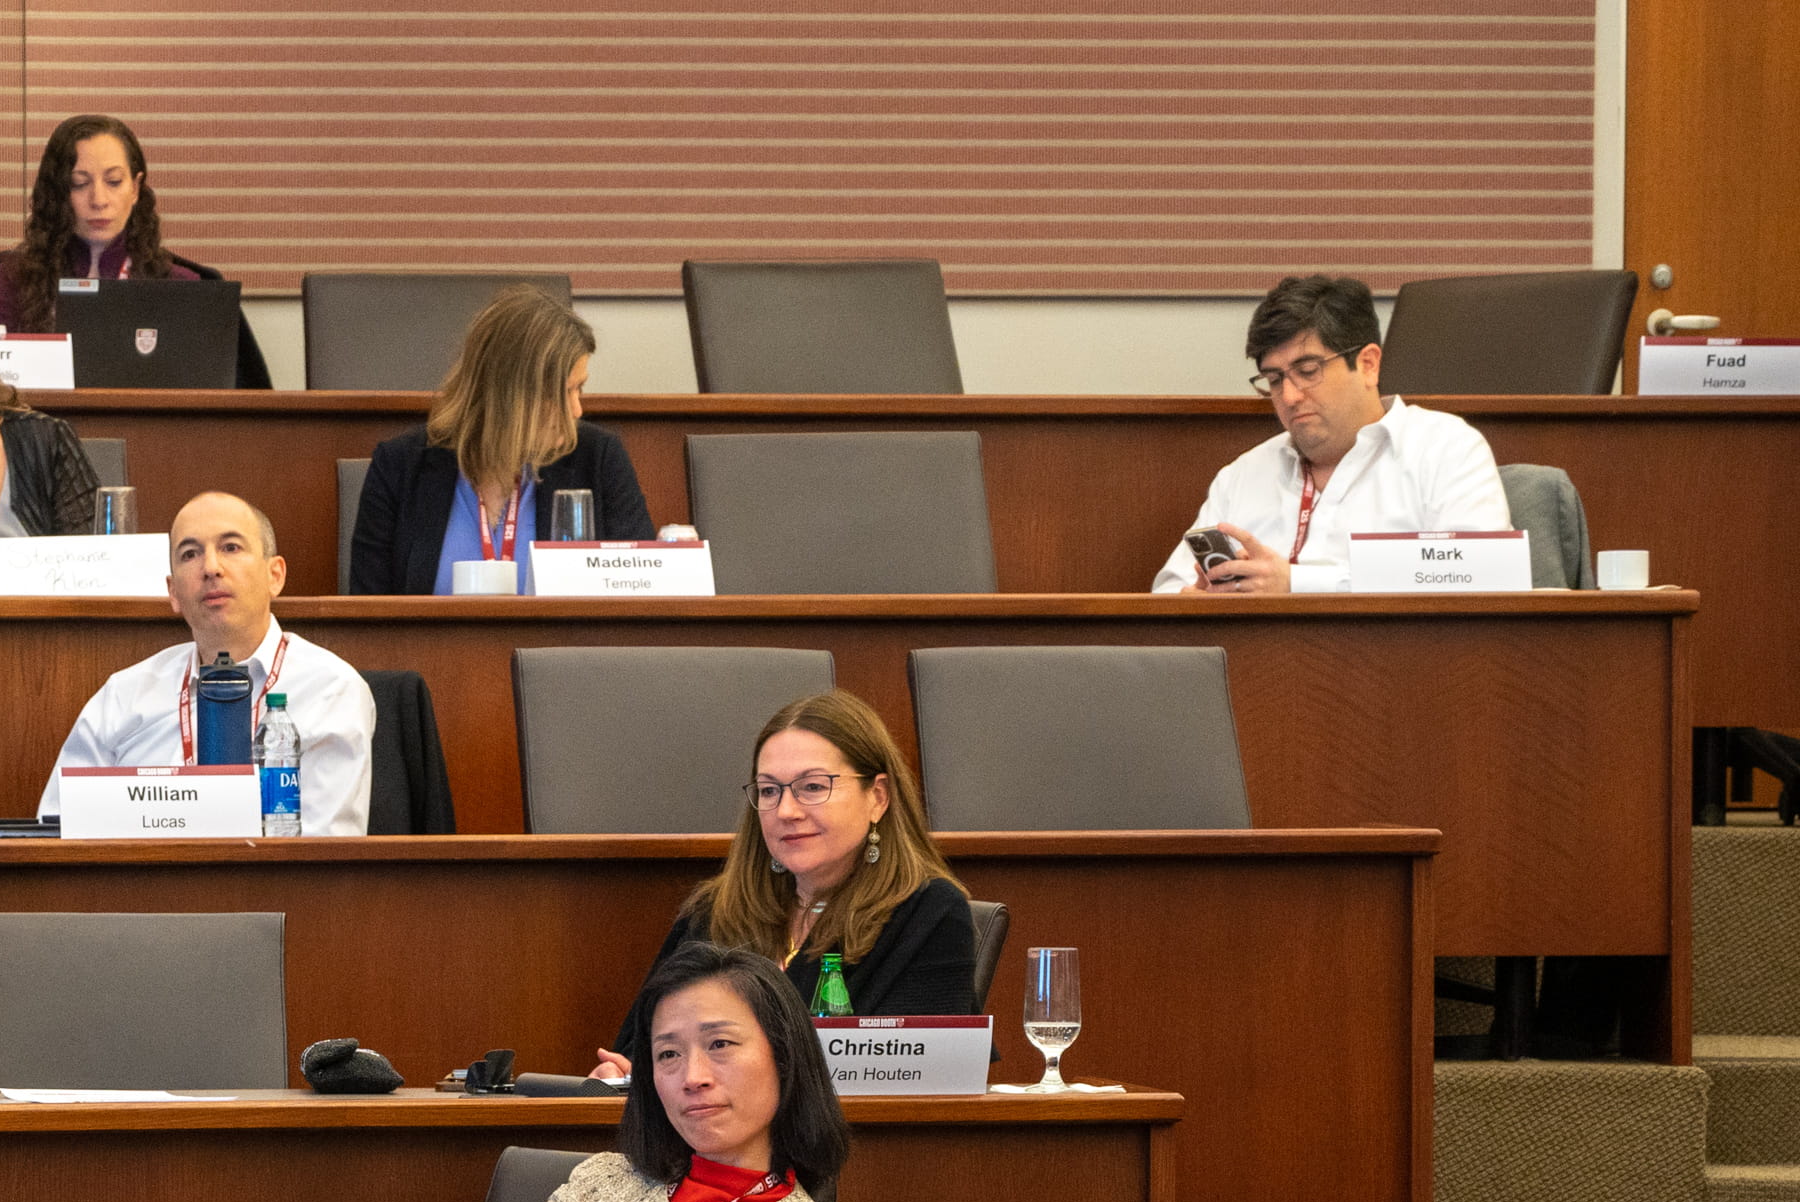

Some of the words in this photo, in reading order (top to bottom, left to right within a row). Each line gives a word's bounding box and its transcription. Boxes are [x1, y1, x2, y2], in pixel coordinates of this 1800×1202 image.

[1706, 354, 1747, 367] Fuad
[1703, 378, 1746, 389] Hamza
[1421, 548, 1464, 561] Mark
[586, 556, 663, 569] Madeline
[604, 578, 652, 591] Temple
[1415, 572, 1472, 584] Sciortino
[127, 786, 198, 801] William
[142, 815, 186, 828] Lucas
[828, 1039, 925, 1056] Christina
[863, 1067, 922, 1081] Houten
